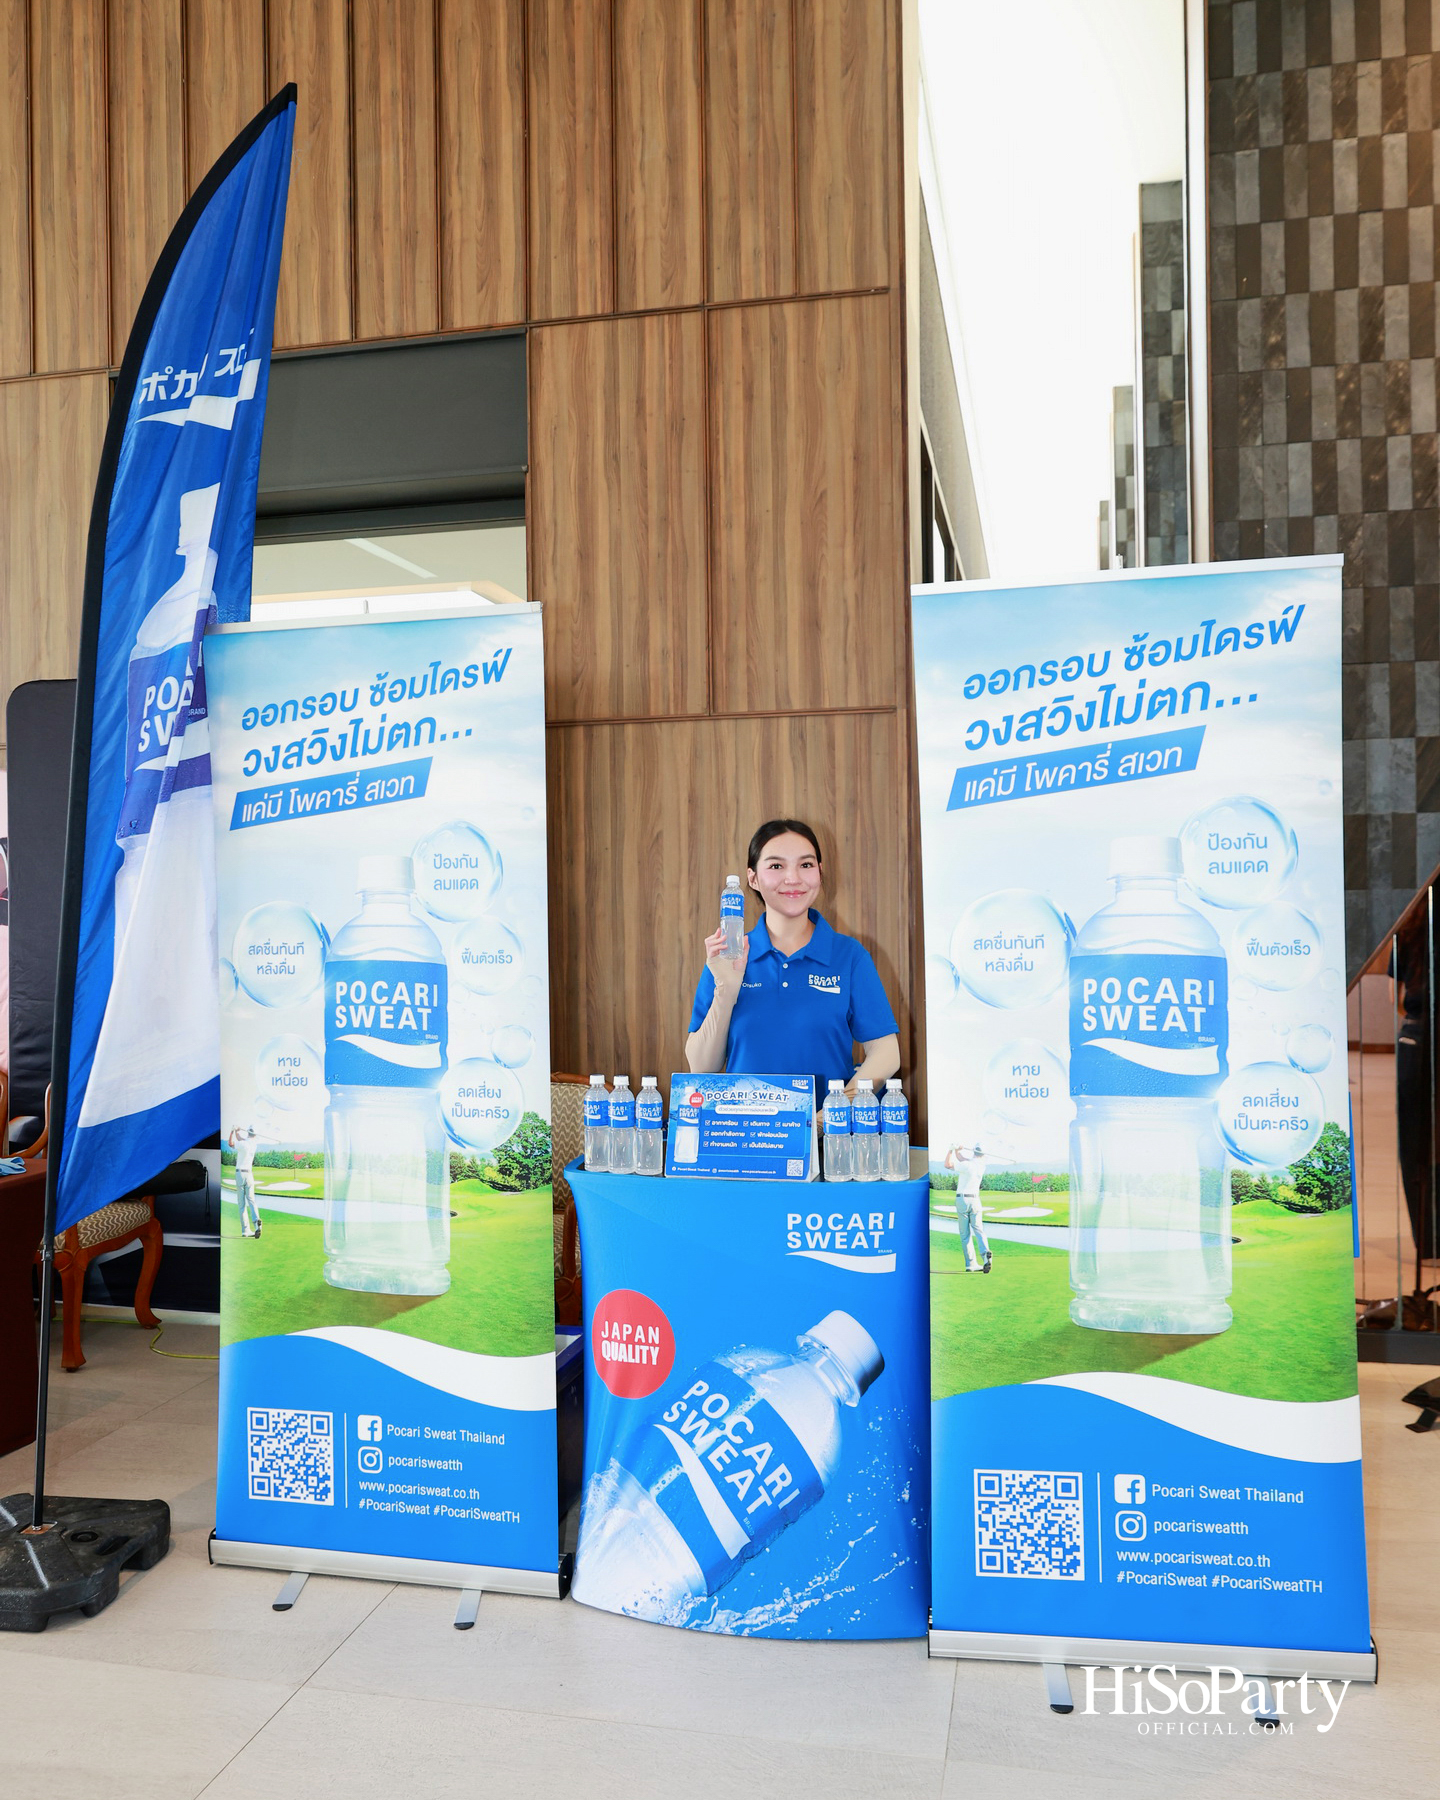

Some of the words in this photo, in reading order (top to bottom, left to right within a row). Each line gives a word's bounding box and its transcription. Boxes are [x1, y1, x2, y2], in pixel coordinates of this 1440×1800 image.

[963, 650, 1110, 699] ออกรอบ
[1124, 604, 1306, 671] ซ้อมไดรฟ์
[242, 688, 359, 731] ออกรอบ
[370, 648, 513, 707] ซ้อมไดรฟ์
[965, 679, 1258, 751] วงสวิงไม่ตก...
[243, 713, 472, 777] วงสวิงไม่ตก...
[964, 766, 1016, 802] แค่มี
[1026, 743, 1113, 791] โพคารี่
[1117, 745, 1183, 777] สเวท
[242, 791, 283, 823] แค่มี
[289, 772, 360, 814] โพคารี่
[364, 775, 415, 802] สเวท
[1208, 832, 1267, 850] ป้องกัน
[433, 853, 479, 870] ป้องกัน
[1208, 860, 1268, 874] ลมแดด
[433, 878, 479, 891] ลมแดด
[248, 939, 305, 956] สดชื่นทันที
[973, 931, 1045, 950] สดชื่นทันที
[1247, 937, 1311, 957] ฟื้นตัวเร็ว
[461, 947, 513, 965] ฟื้นตัวเร็ว
[985, 953, 1034, 972] หลังดื่ม
[256, 958, 296, 975] หลังดื่ม
[335, 981, 438, 1007] POCARI
[1083, 977, 1215, 1005] POCARI
[335, 1005, 431, 1031] SWEAT
[1083, 1004, 1206, 1032] SWEAT
[277, 1057, 301, 1067] หาย
[1012, 1064, 1041, 1077] หาย
[271, 1070, 308, 1087] เหนื่อย
[458, 1080, 502, 1099] ลดเสี่ยง
[707, 1092, 748, 1101] POCARI
[752, 1092, 788, 1101] SWEAT
[1005, 1079, 1049, 1099] เหนื่อย
[1242, 1088, 1299, 1107] ลดเสี่ยง
[451, 1102, 510, 1119] เป็นตะคริว
[1234, 1112, 1309, 1130] เป็นตะคริว
[787, 1212, 895, 1230] POCARI
[787, 1231, 884, 1249] SWEAT
[601, 1320, 660, 1345] JAPAN
[601, 1339, 660, 1366] QUALITY
[387, 1424, 421, 1438] Pocari
[424, 1427, 457, 1441] Sweat
[460, 1430, 505, 1445] Thailand
[682, 1379, 800, 1509] POCARI
[388, 1455, 463, 1471] pocarisweatth
[663, 1401, 773, 1514] SWEAT
[359, 1480, 480, 1500] www.pocarisweat.co.th
[1152, 1484, 1194, 1499] Pocari
[1199, 1485, 1241, 1500] Sweat
[1244, 1487, 1304, 1503] Thailand
[359, 1498, 430, 1516] #PocariSweat
[434, 1505, 520, 1523] #PocariSweatTH
[1154, 1519, 1249, 1535] pocarisweatth
[1117, 1549, 1270, 1568] www.pocarisweat.co.th
[1117, 1570, 1207, 1588] #PocariSweat
[1211, 1575, 1323, 1593] #PocariSweatTH
